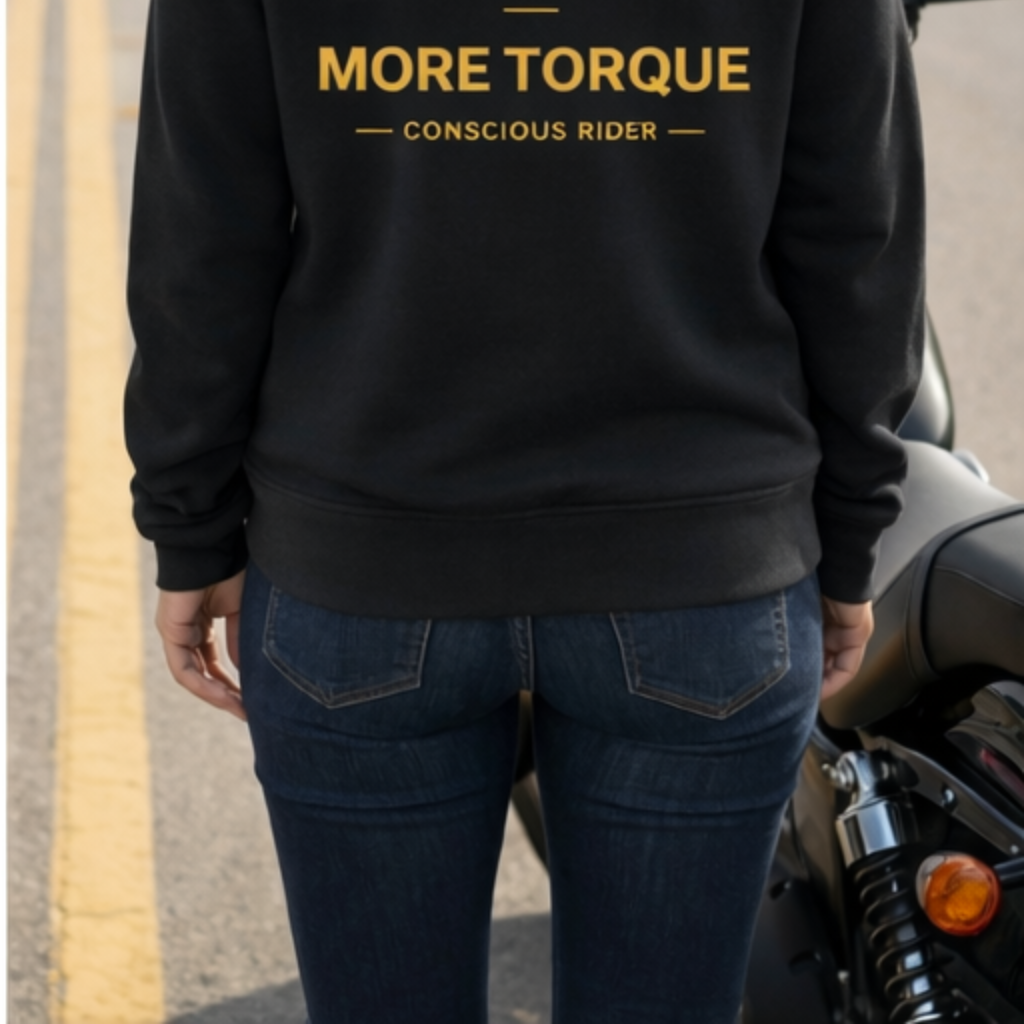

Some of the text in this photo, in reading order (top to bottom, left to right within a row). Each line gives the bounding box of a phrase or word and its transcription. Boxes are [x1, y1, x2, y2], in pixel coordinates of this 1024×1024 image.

[318, 46, 751, 98] MORE TORQUE
[403, 120, 657, 142] CONSCIOUS RIDER
